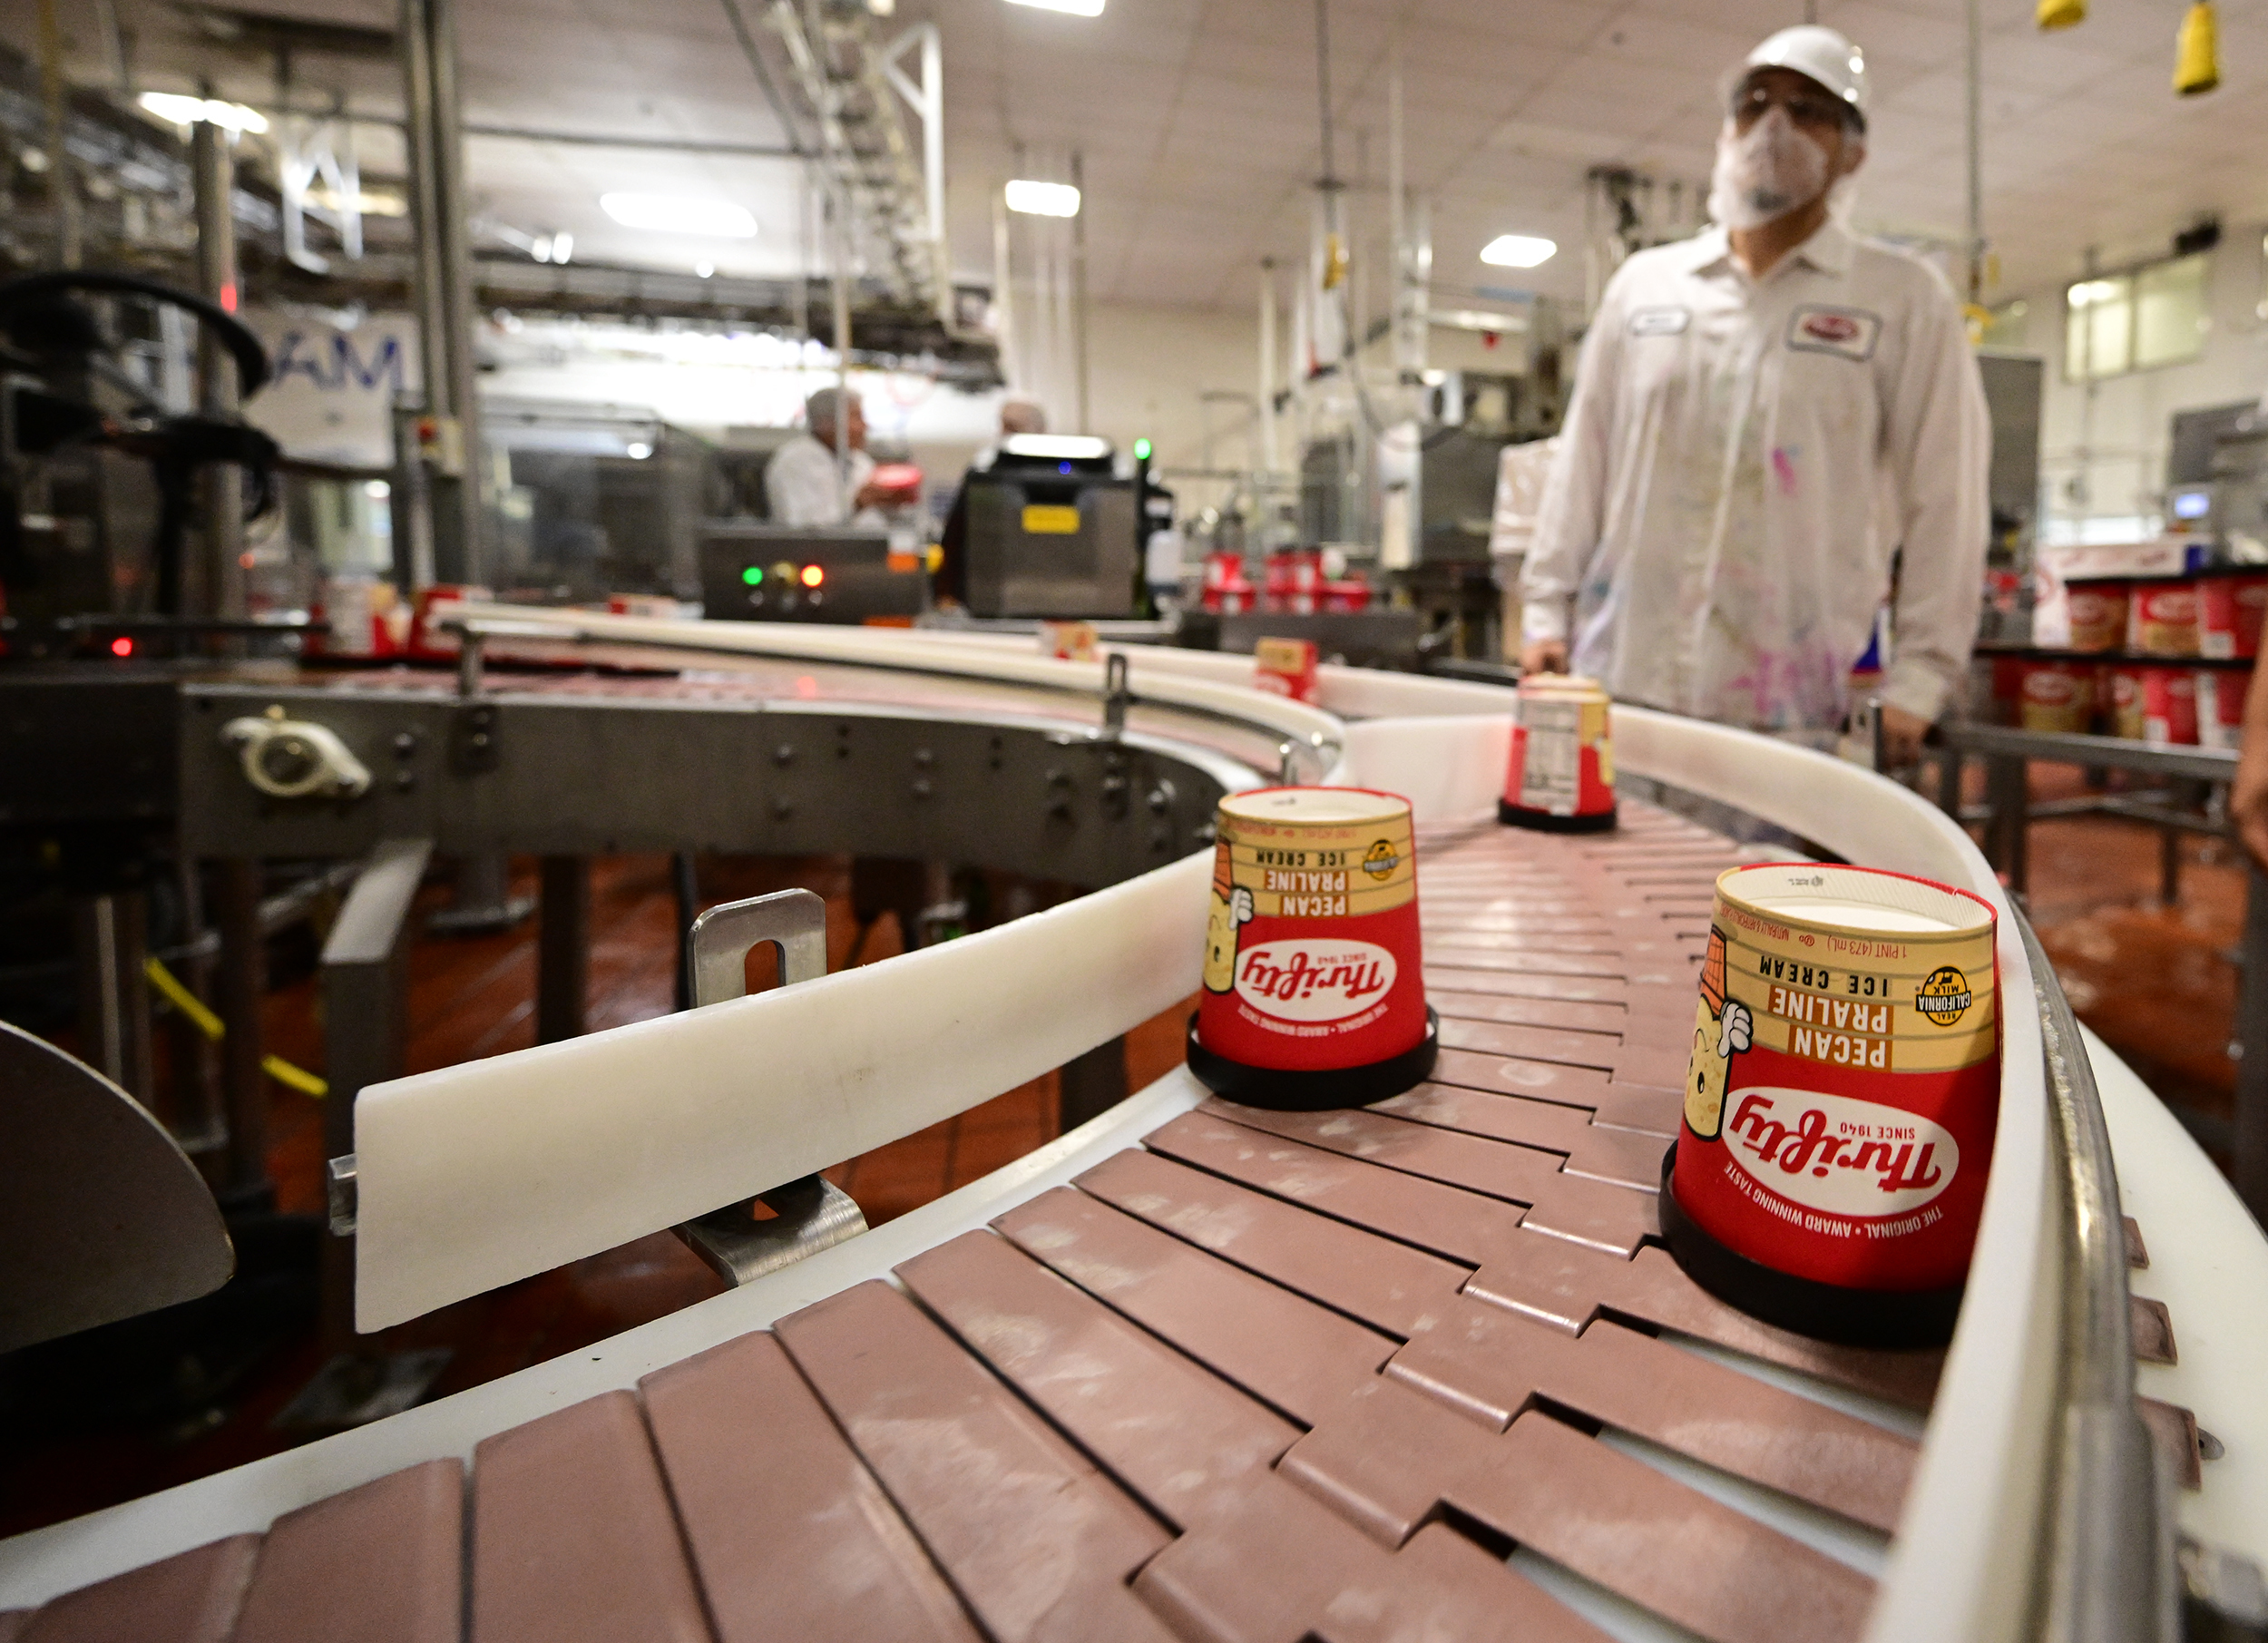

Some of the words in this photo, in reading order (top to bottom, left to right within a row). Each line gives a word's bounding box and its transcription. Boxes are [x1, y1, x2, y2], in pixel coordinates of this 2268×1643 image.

[1256, 851, 1306, 866] CREAM
[1317, 853, 1345, 866] ICE
[1266, 871, 1346, 892] PRALINE
[1283, 895, 1346, 916] PECAN
[1761, 922, 1790, 942] NATURALLY
[1826, 934, 1847, 952] mL)
[1849, 940, 1872, 957] (473
[1874, 944, 1899, 959] PINT
[1240, 951, 1385, 1001] Thrifty
[1759, 955, 1830, 990] CREAM
[1848, 974, 1889, 997] ICE
[1933, 984, 1960, 995] MILK
[1773, 986, 1889, 1033] PRALINE
[1918, 990, 1972, 1012] CALIFORNIA
[1941, 1012, 1958, 1021] REAL
[1794, 1027, 1887, 1069] PECAN
[1840, 1121, 1872, 1138] 1940
[1877, 1126, 1915, 1140] SINCE
[1728, 1094, 1942, 1192] Thrifty
[1723, 1160, 1752, 1198] TASTE
[1752, 1191, 1803, 1226] WINNING
[1921, 1205, 1943, 1227] THE
[1804, 1213, 1853, 1238] AWARD
[1863, 1219, 1921, 1239] ORIGINAL
